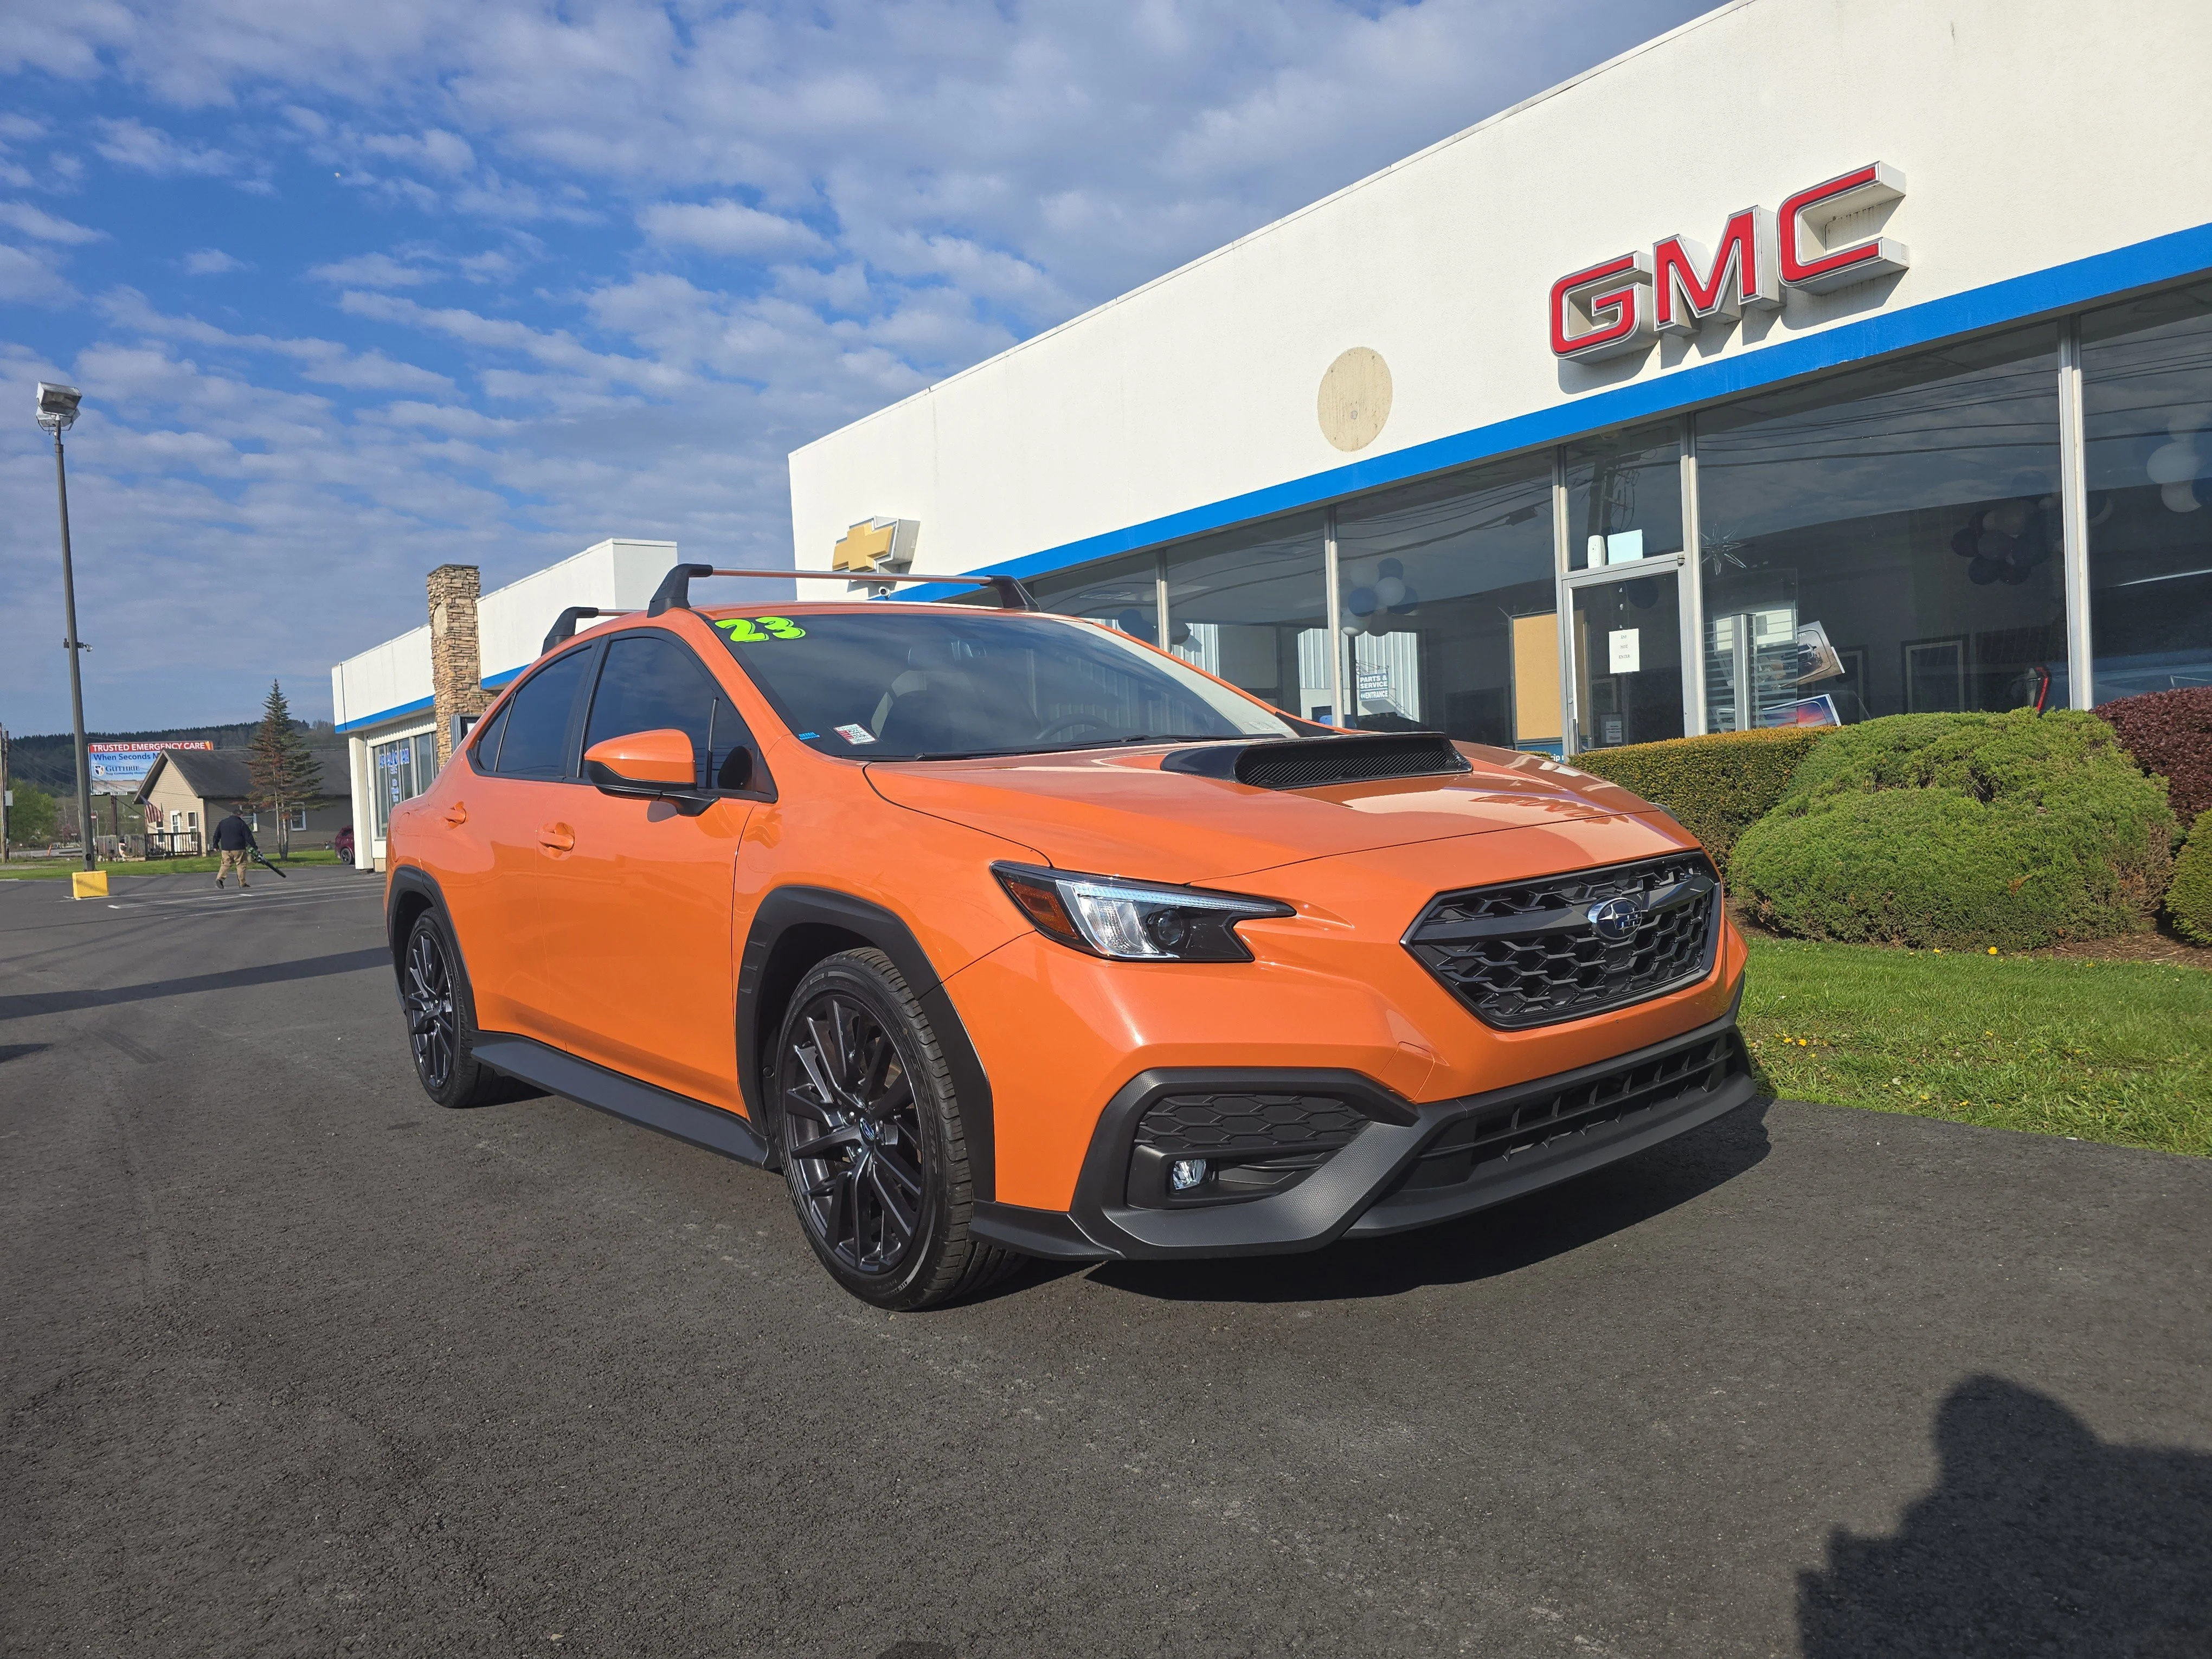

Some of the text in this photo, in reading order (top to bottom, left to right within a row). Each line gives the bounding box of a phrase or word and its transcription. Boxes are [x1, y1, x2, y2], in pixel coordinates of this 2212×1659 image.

[1549, 160, 1907, 360] GMC
[715, 616, 806, 642] 23
[1360, 681, 1388, 689] SERVICE
[1365, 690, 1388, 699] ENTRANCE
[92, 744, 130, 752] TRUSTED
[131, 743, 183, 751] EMERGENCY
